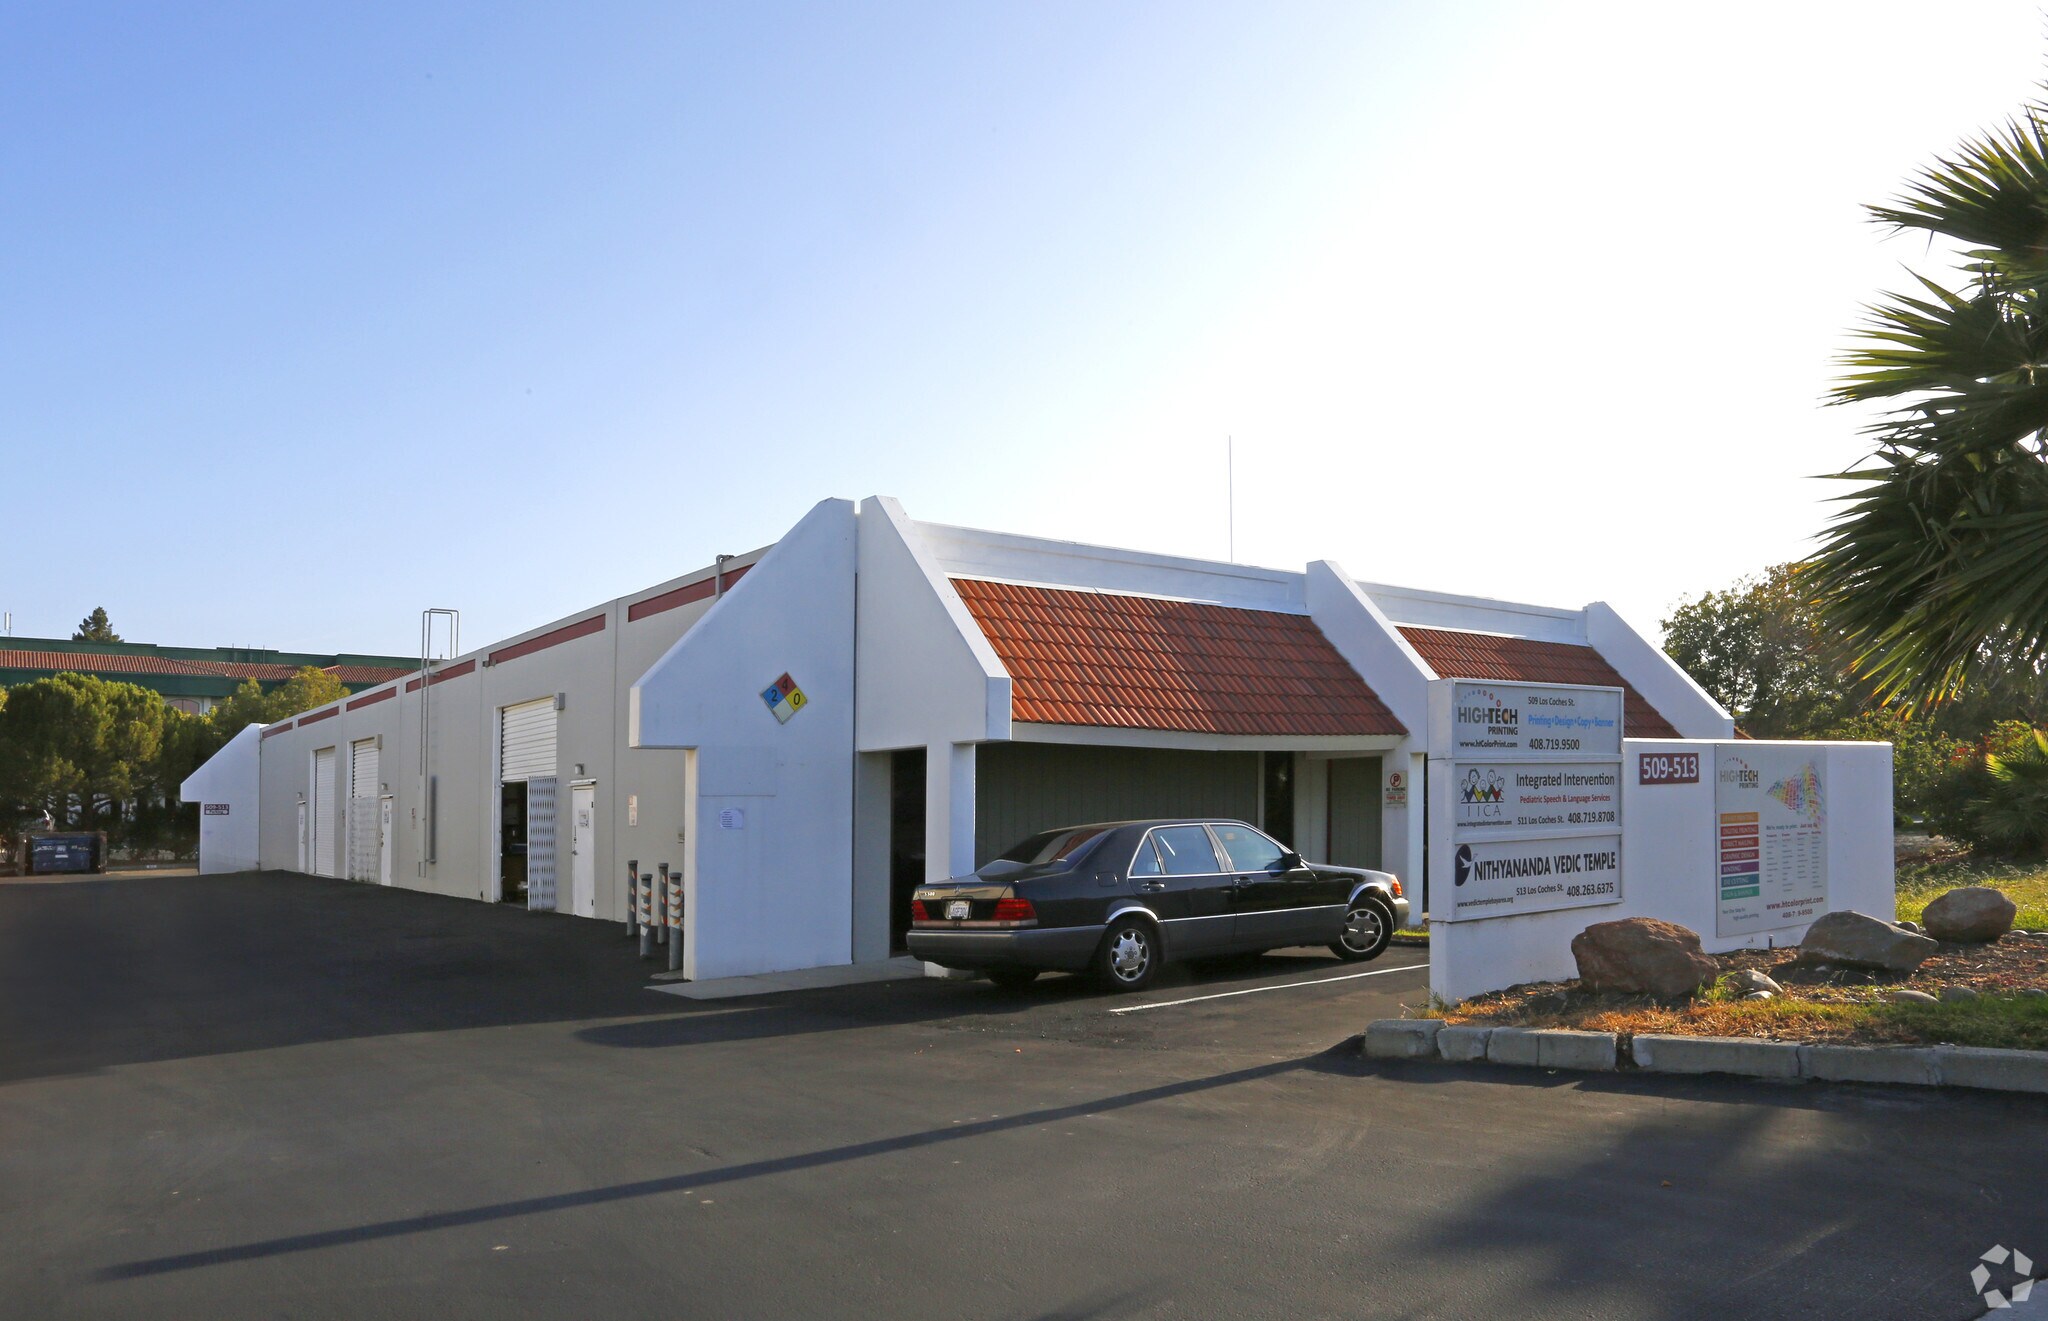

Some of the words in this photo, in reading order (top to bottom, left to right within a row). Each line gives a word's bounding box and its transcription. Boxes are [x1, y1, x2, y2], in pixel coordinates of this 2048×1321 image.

[782, 679, 788, 691] 4
[771, 688, 778, 702] 2
[793, 692, 801, 705] 0
[1528, 696, 1538, 705] 509
[1549, 698, 1568, 706] Coches
[1458, 707, 1518, 724] HIGHTECH
[1488, 726, 1518, 735] PRINTING
[1529, 739, 1580, 750] 408.719.9500
[1643, 756, 1697, 779] 509-513
[1516, 773, 1562, 789] Integrated
[1564, 773, 1615, 786] Intervention
[1520, 795, 1542, 803] Pediatric
[1543, 795, 1562, 804] Speech
[1591, 794, 1611, 802] Services
[1517, 817, 1527, 825] 511
[1528, 816, 1537, 824] Los
[1538, 816, 1556, 824] Coches
[1567, 811, 1615, 824] 408.719.8708
[1474, 856, 1552, 881] NITHYANANDA
[1553, 854, 1581, 874] VEDIC
[1583, 851, 1616, 871] TEMPLE
[1516, 887, 1527, 896] 513
[1527, 886, 1537, 895] Los
[1538, 884, 1556, 894] Coches
[1556, 883, 1564, 892] St.
[1566, 882, 1614, 897] 408.263.6375
